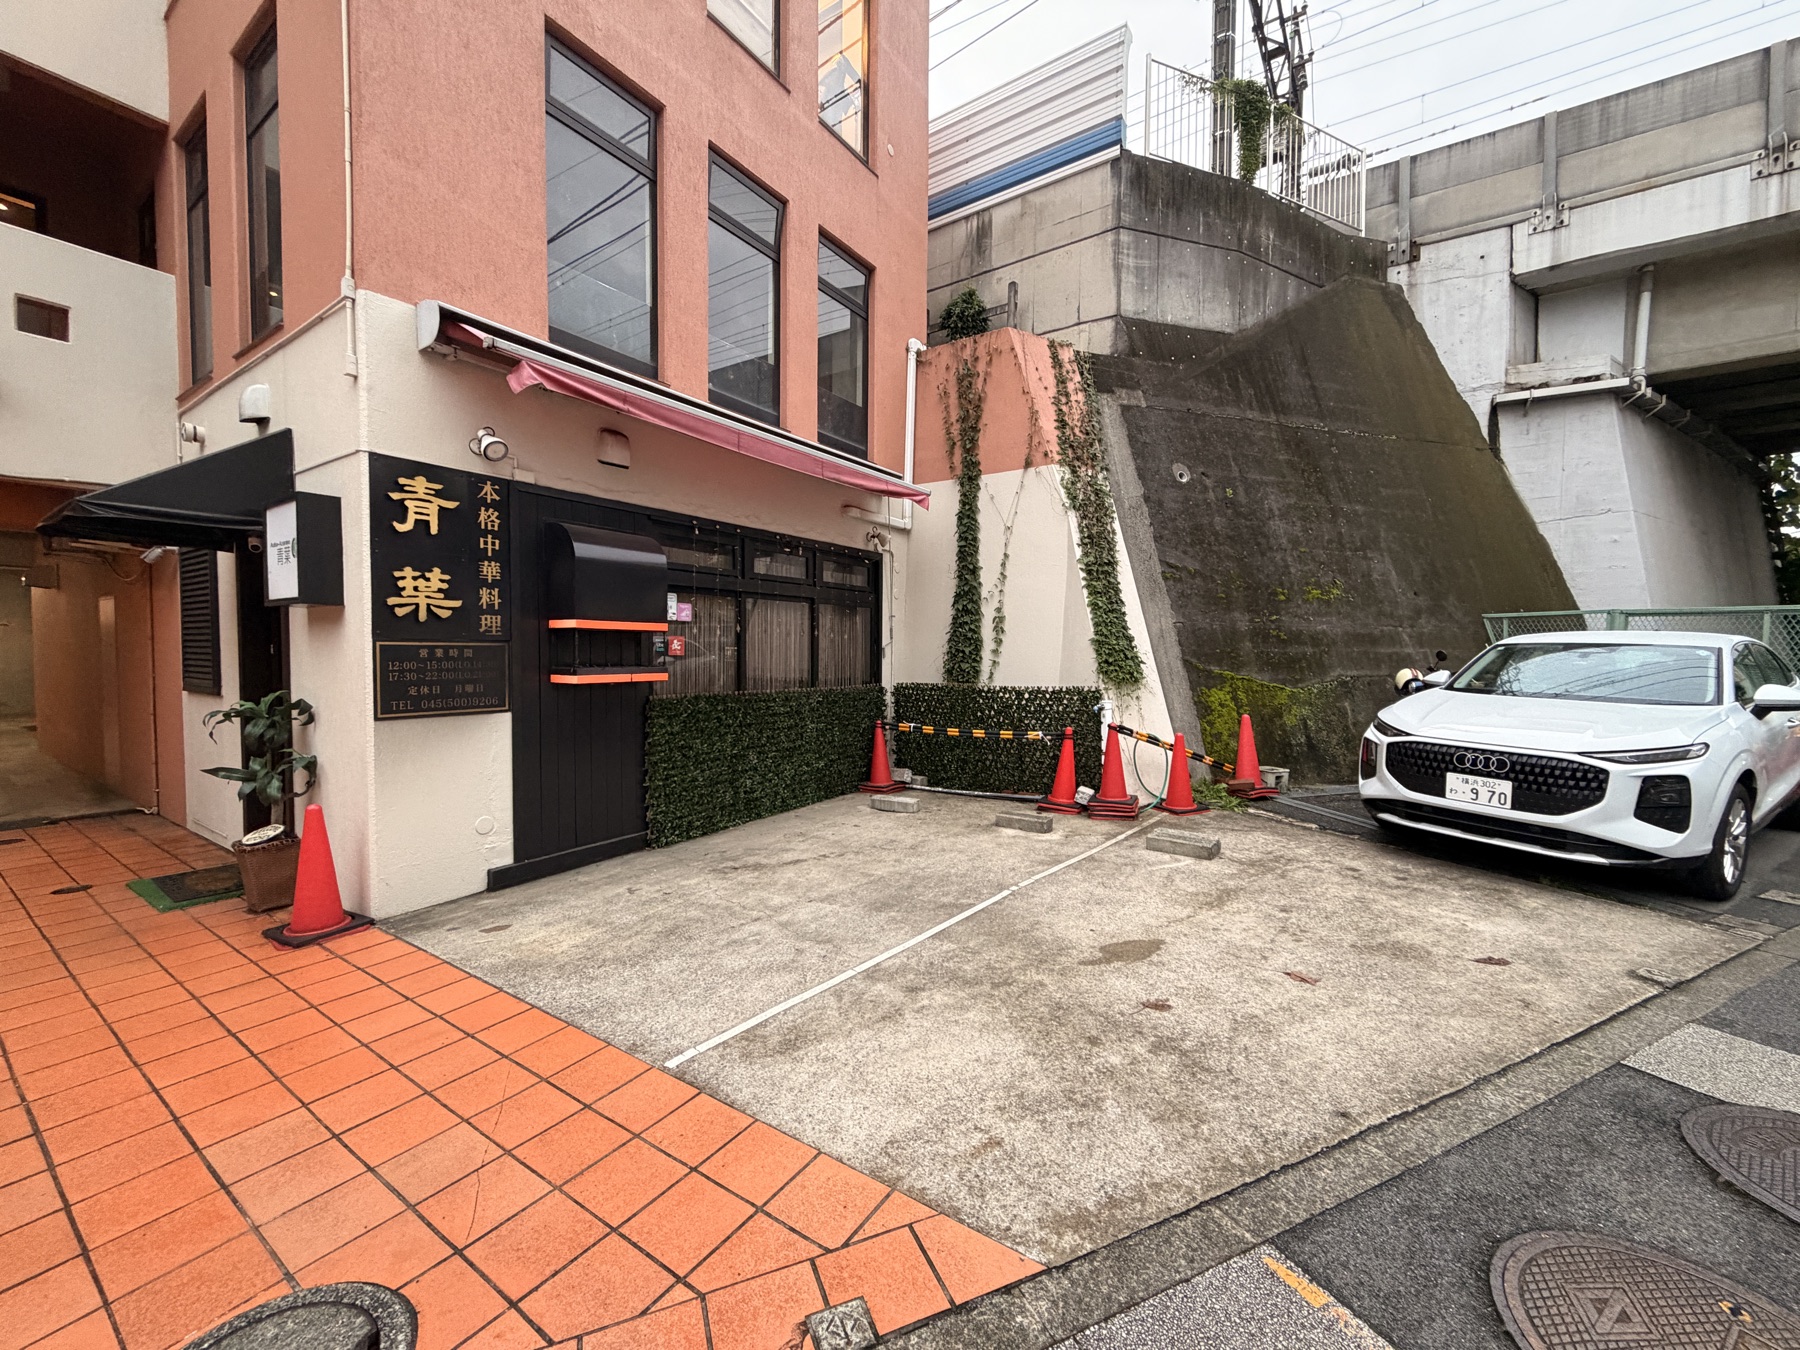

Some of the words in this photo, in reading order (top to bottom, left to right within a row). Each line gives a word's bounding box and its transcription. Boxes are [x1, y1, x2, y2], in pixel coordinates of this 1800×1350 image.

[386, 475, 463, 622] 青葉
[476, 480, 503, 636] 本格中華料理
[418, 648, 473, 658] 営業時間
[407, 685, 441, 696] 定休日
[454, 684, 484, 694] 月曜日
[390, 700, 414, 711] TEL
[421, 696, 499, 709] 045(500)9206
